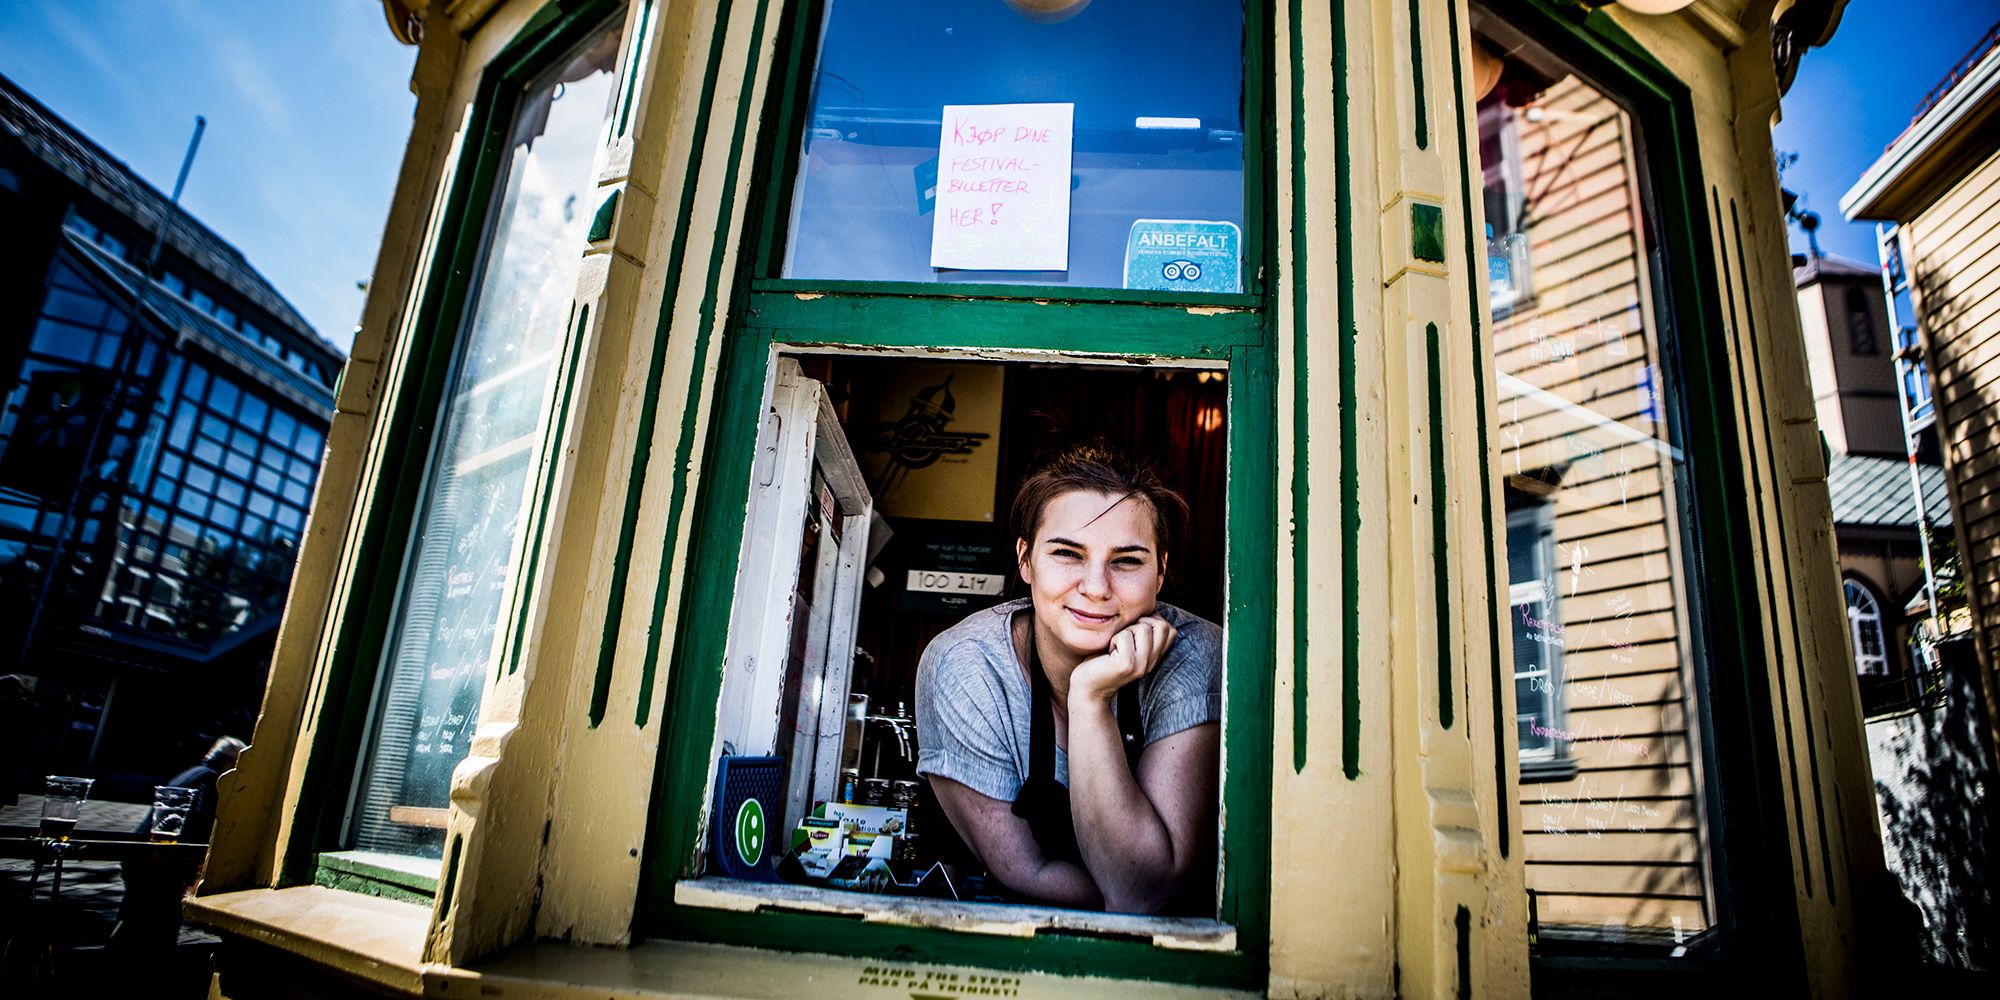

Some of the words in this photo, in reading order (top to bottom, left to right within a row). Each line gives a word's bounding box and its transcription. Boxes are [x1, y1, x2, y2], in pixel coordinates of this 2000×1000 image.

[1014, 128, 1052, 144] DINE
[951, 156, 1041, 172] FESTIVAL-
[947, 178, 1030, 195] BILLETTER
[1138, 233, 1229, 248] ANBEFALT
[918, 572, 950, 589] 100
[863, 966, 916, 978] MIND
[926, 971, 959, 983] THE
[858, 976, 899, 988] PASS
[908, 979, 929, 991] PÅ
